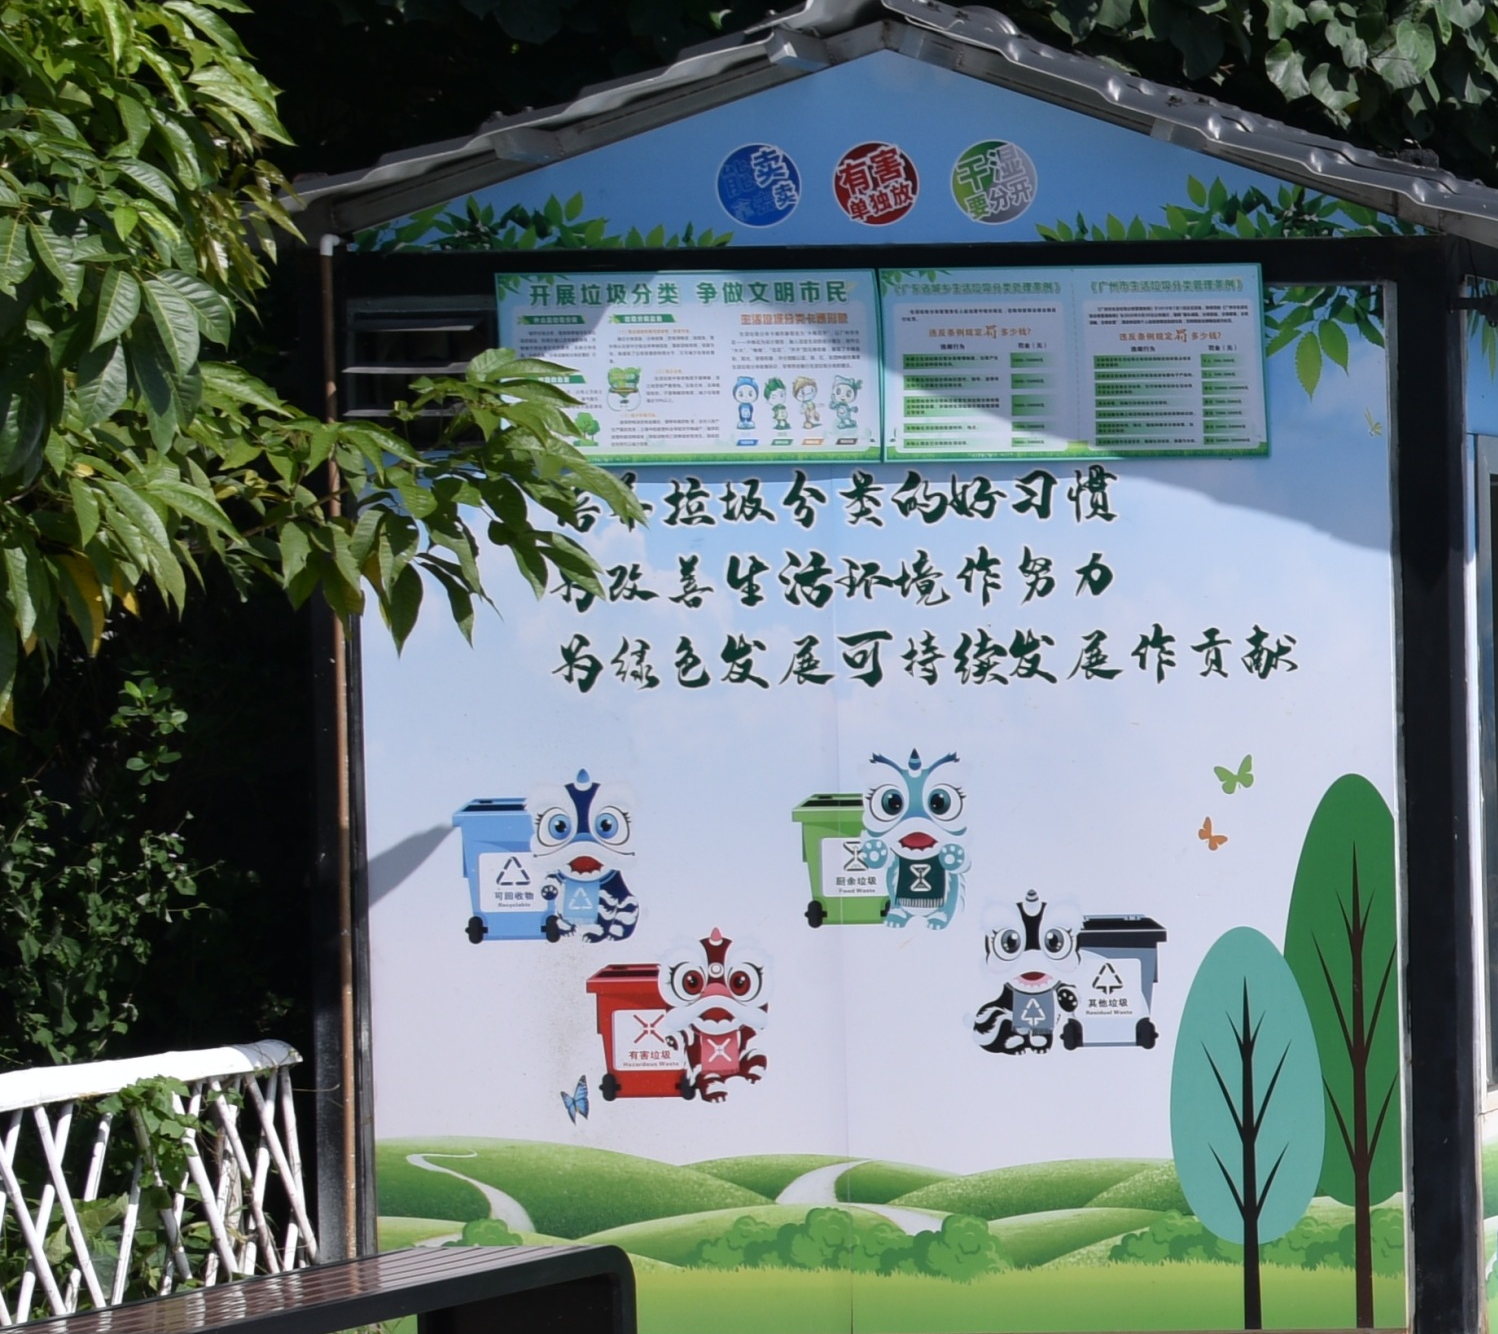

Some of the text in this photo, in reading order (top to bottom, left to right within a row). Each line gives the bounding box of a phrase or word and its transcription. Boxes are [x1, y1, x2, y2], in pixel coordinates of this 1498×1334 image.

[840, 145, 906, 193] 有害
[957, 144, 1024, 193] 干湿
[850, 182, 914, 222] 单独放
[966, 181, 1033, 221] 要分开
[529, 280, 848, 306] 开展垃圾分类 争做文明市民
[551, 623, 1298, 693] 为绿色发展可持续发展作贡献
[494, 891, 534, 901] 可回收物
[836, 876, 877, 886] 厨余垃圾
[1088, 998, 1128, 1008] 其他垃圾
[628, 1050, 672, 1061] 有害垃圾
